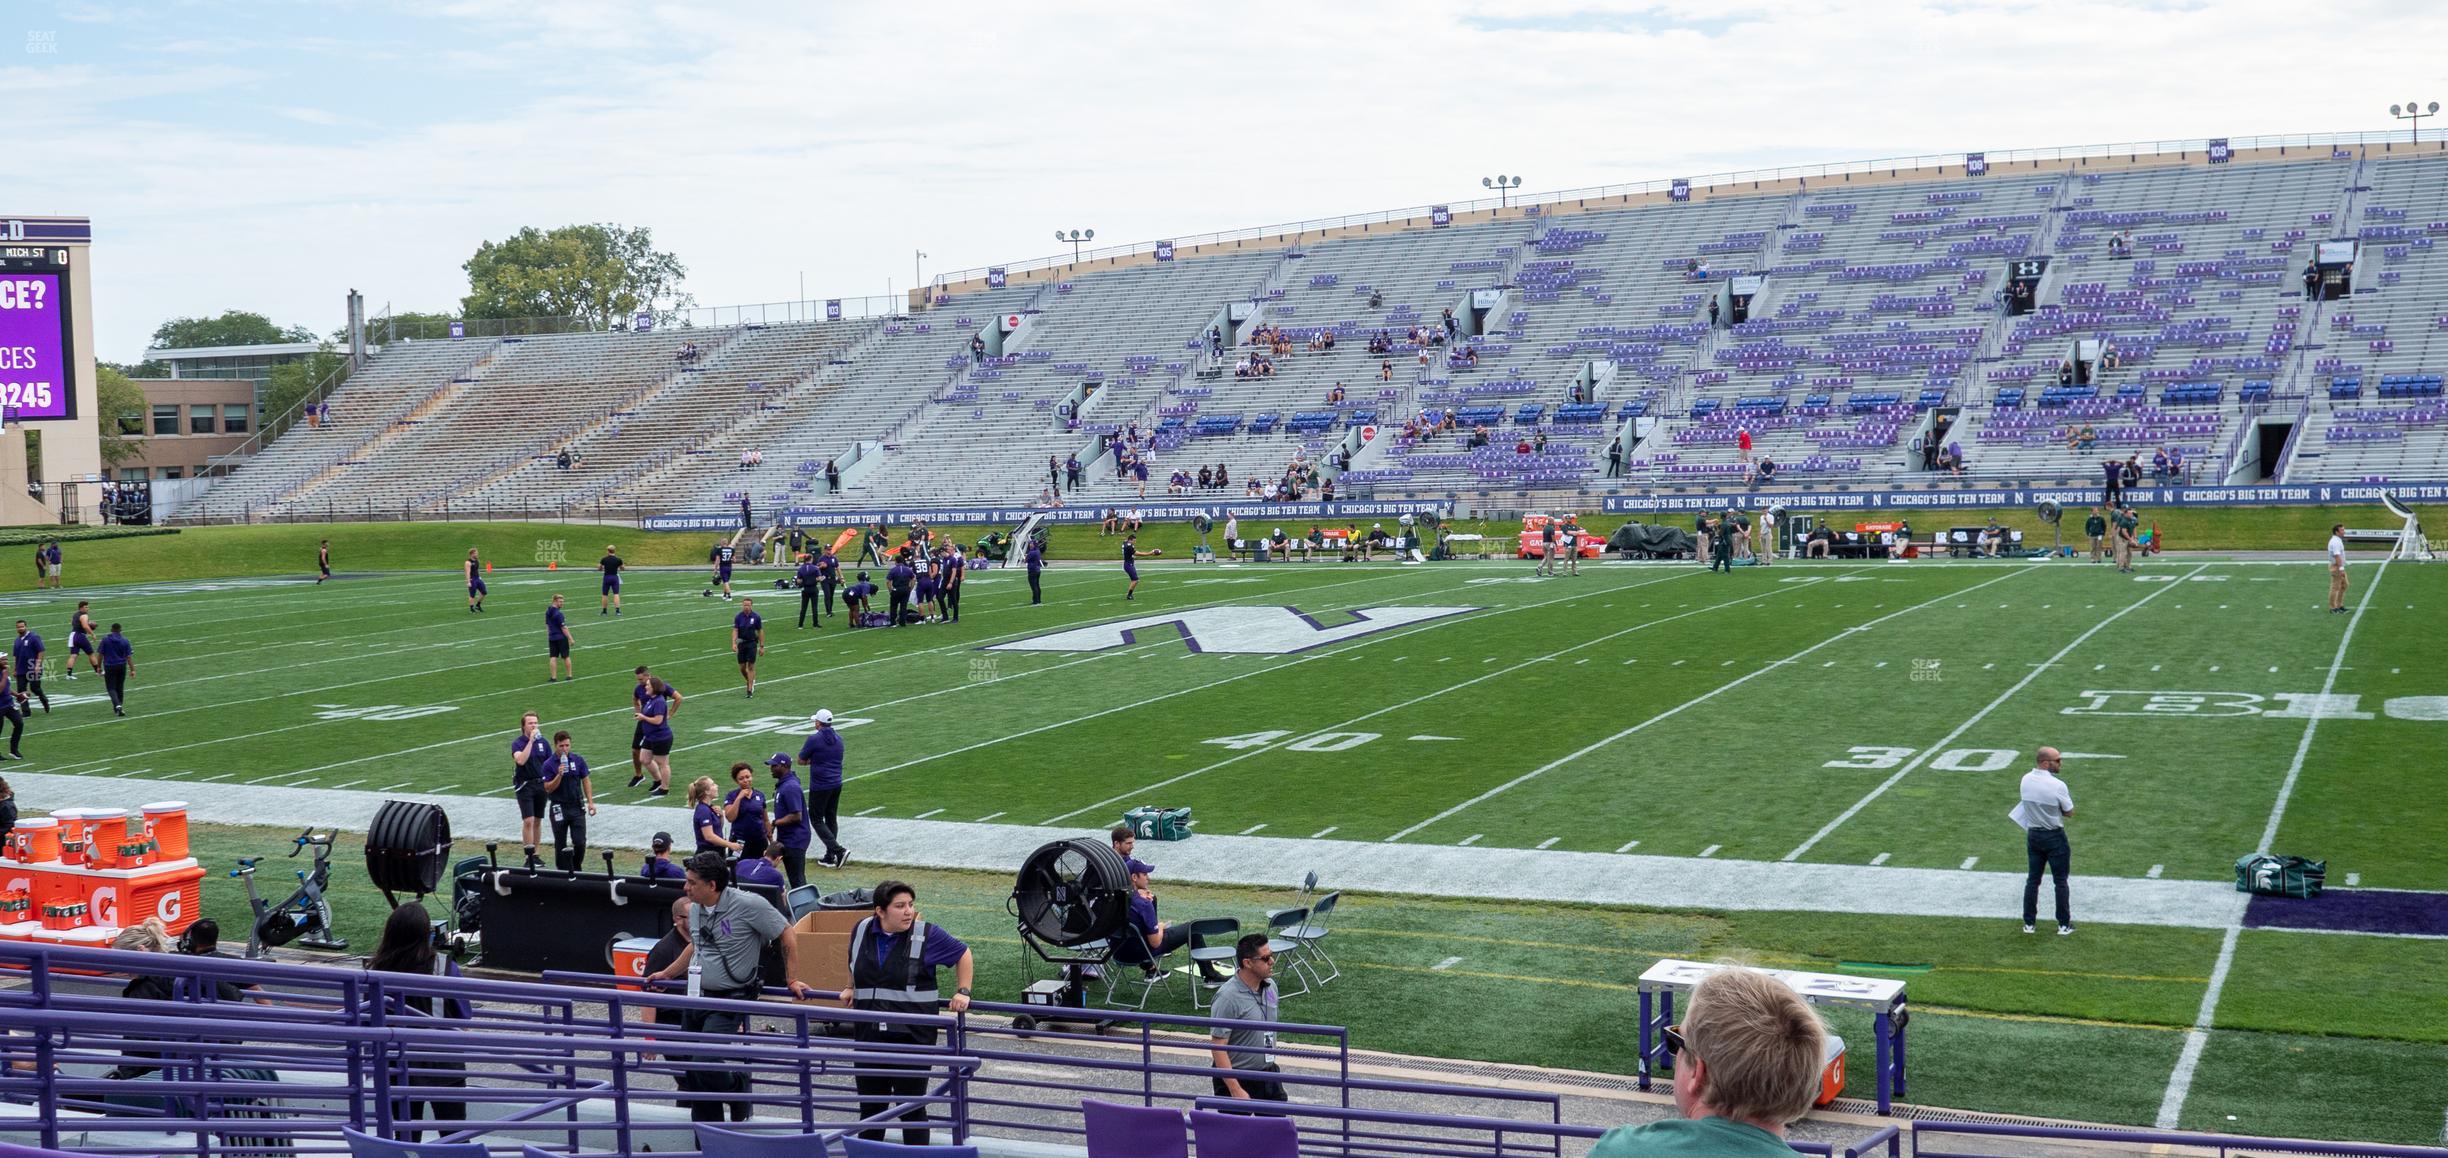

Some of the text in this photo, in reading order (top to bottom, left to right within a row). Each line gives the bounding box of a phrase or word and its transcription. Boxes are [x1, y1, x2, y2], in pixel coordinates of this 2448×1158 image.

[1674, 186, 1687, 196] 107
[6, 248, 45, 257] MICH ST
[1158, 248, 1171, 258] 105
[990, 274, 1004, 284] 104
[2085, 492, 2101, 502] BIG
[2125, 491, 2154, 501] TEAM
[2183, 491, 2235, 500] CHICAGO'S
[2238, 490, 2255, 499] BIG
[2257, 490, 2278, 499] TEN
[2281, 489, 2310, 499] TEAM
[2399, 487, 2417, 497] BIG
[2421, 487, 2442, 497] TEN
[1669, 498, 1683, 508] BIG
[1685, 498, 1702, 507] TEN
[1704, 497, 1728, 507] TEAM
[1754, 496, 1799, 506] CHICAGO'S
[1801, 496, 1817, 506] BIG
[1819, 496, 1836, 505] TEN
[1838, 495, 1864, 505] TEAM
[1891, 494, 1938, 504] CHICAGO'S
[1940, 494, 1955, 504] BIG
[1958, 494, 1977, 504] TEN
[1979, 493, 2005, 503] TEAM
[1154, 508, 1166, 517] BIG
[1168, 508, 1181, 517] TEN
[1267, 506, 1280, 515] BIG
[1282, 506, 1296, 515] TEN
[1298, 505, 1320, 514] TEAM
[1341, 505, 1381, 514] CHICAGO'S
[1383, 505, 1396, 513] BIG
[1398, 504, 1413, 513] TEN
[937, 514, 949, 522] BIG
[951, 513, 965, 521] TEN
[966, 513, 986, 521] TEAM
[1058, 510, 1071, 519] TEN
[1073, 510, 1094, 519] TEAM
[653, 519, 688, 528] CHICAGO'S
[689, 519, 700, 527] BIG
[702, 519, 714, 527] TEN
[716, 518, 736, 527] TEAM
[797, 516, 832, 525] CHICAGO'S
[833, 516, 845, 525] BIG
[847, 515, 860, 524] TEN
[861, 515, 881, 524] TEAM
[722, 552, 732, 562] 37
[915, 562, 928, 573] 38
[1200, 730, 1382, 751] 40
[1822, 746, 2020, 771] 30
[158, 891, 181, 922] G
[1832, 1060, 1841, 1084] G
